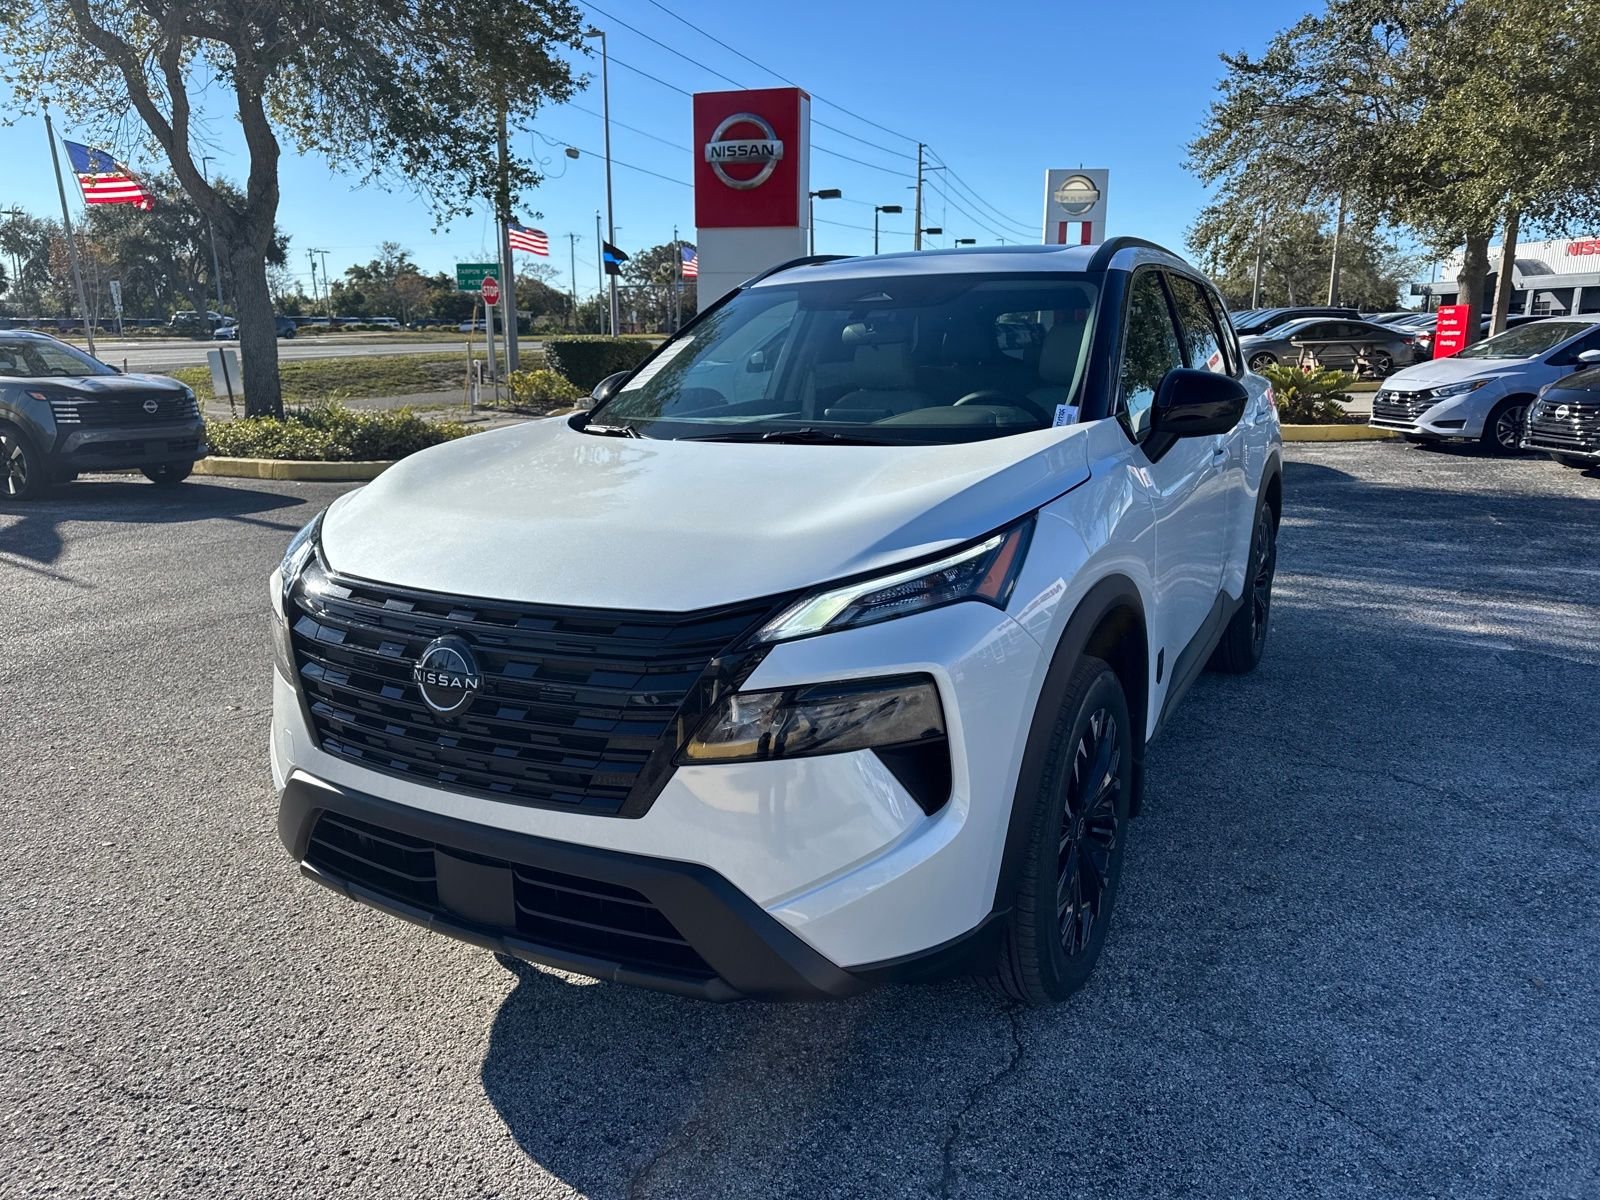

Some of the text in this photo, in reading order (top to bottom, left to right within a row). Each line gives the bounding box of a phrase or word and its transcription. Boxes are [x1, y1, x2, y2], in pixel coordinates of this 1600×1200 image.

[711, 144, 774, 158] NISSAN
[483, 286, 498, 296] STOP
[413, 668, 478, 689] NISSAN
